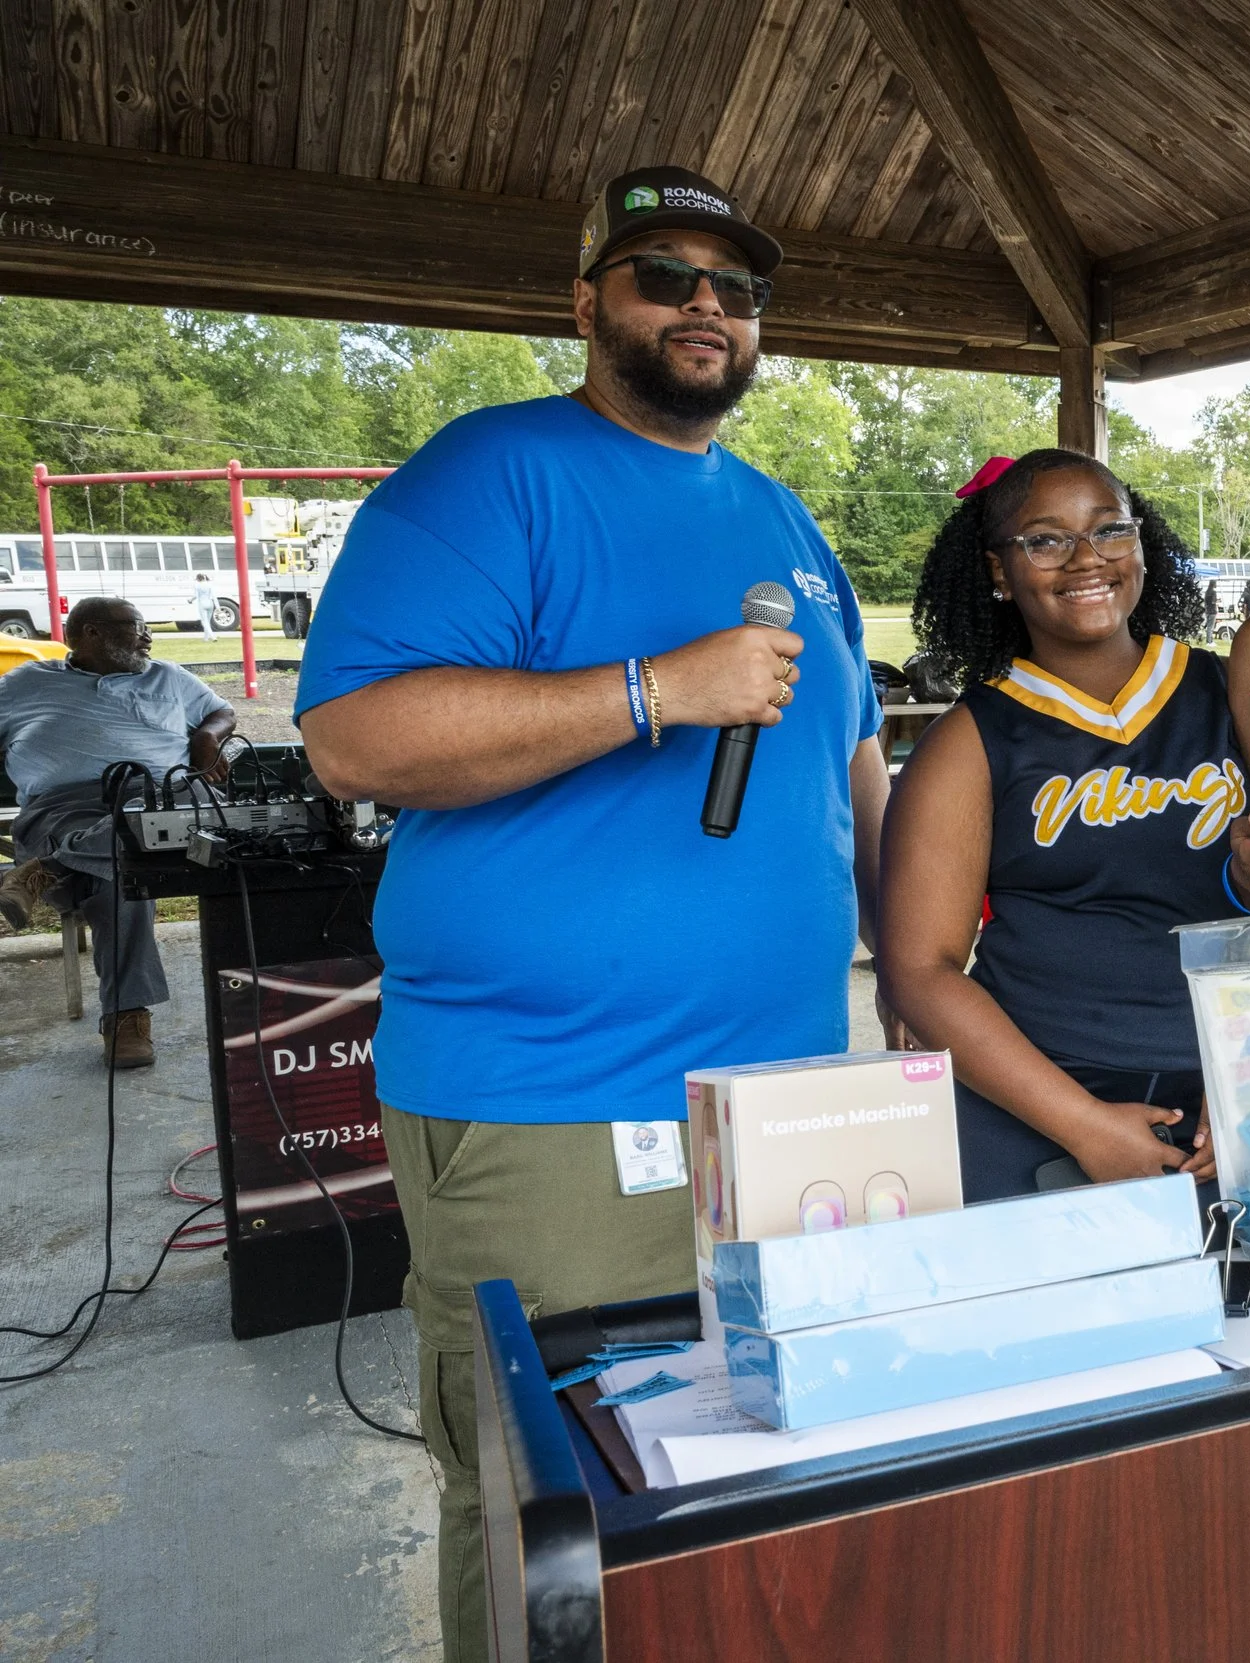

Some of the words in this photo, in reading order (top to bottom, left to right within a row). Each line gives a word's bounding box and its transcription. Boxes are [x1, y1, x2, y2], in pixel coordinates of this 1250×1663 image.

[664, 187, 732, 215] ROANOKE
[630, 684, 645, 723] BRONCOS
[1032, 758, 1246, 850] Vikings
[274, 1046, 317, 1076] DJ
[763, 1115, 845, 1137] Karaoke
[848, 1103, 930, 1125] Machine
